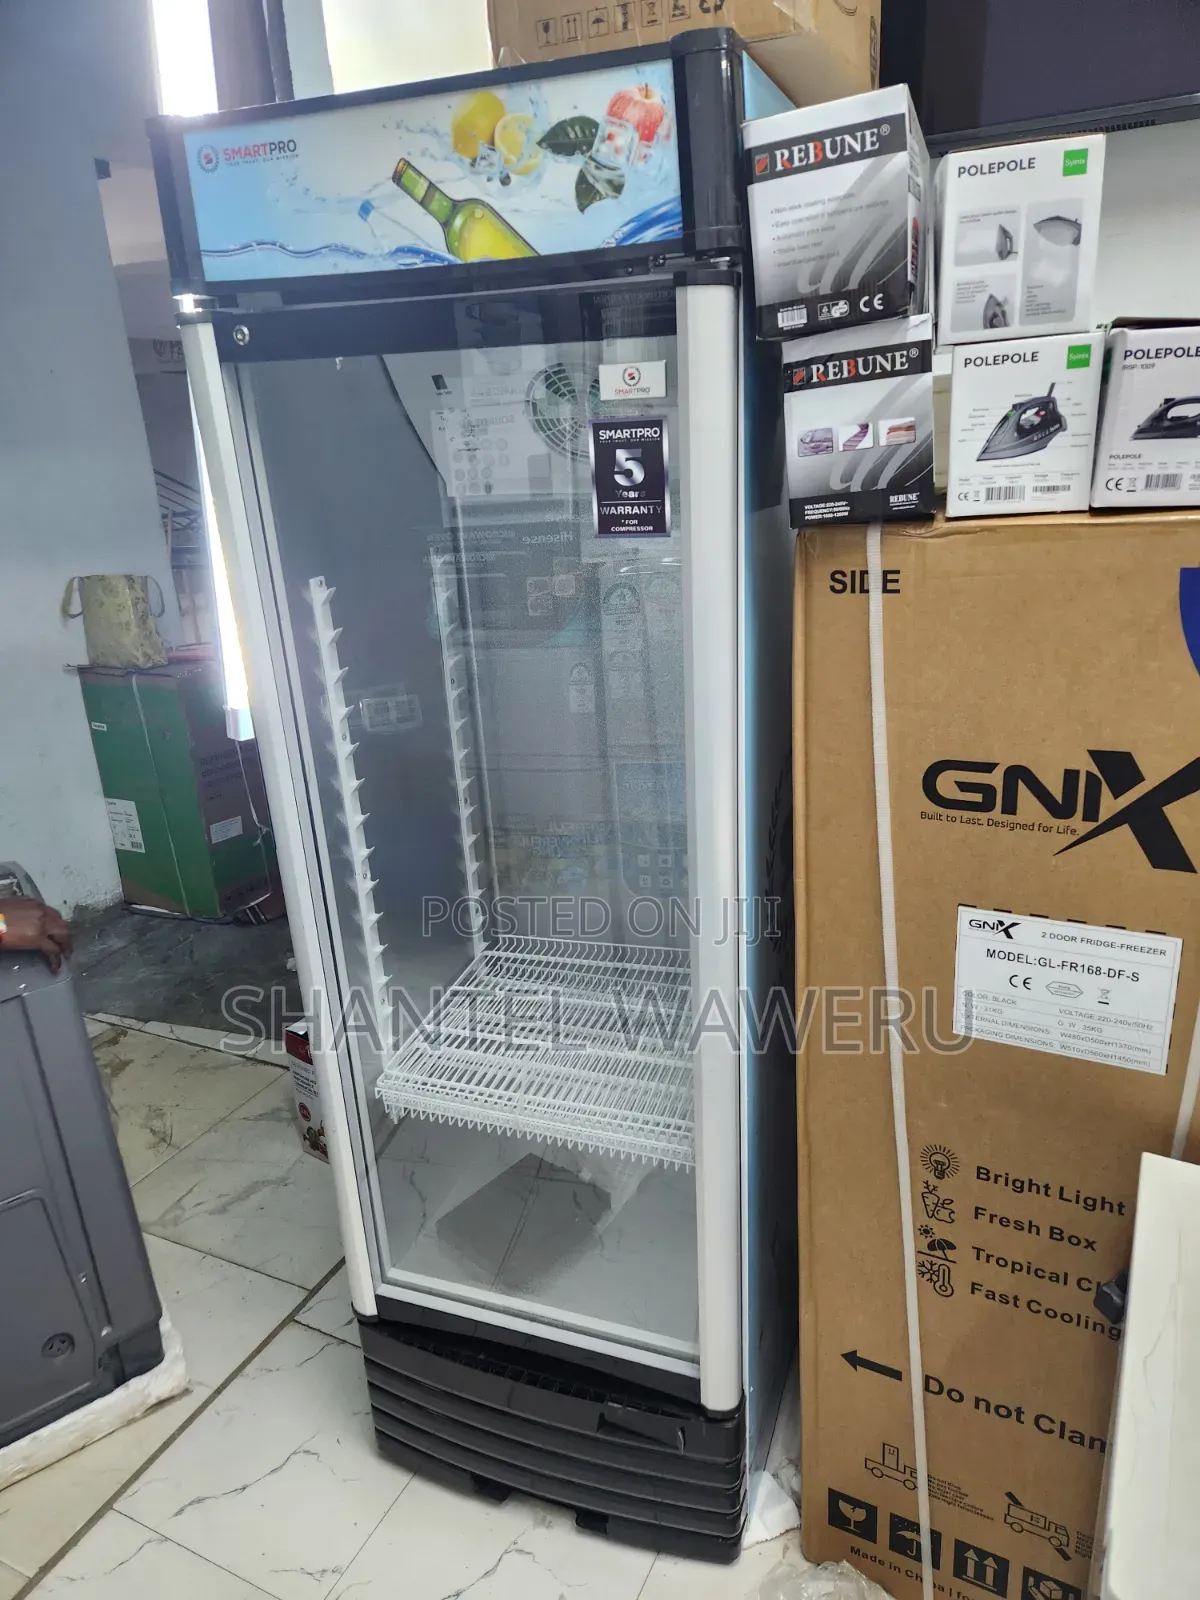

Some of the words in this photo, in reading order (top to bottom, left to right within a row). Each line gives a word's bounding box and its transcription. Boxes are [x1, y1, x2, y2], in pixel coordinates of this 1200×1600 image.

[223, 139, 297, 162] SMARTPRO
[957, 157, 1036, 178] POLEPOLE
[964, 351, 1040, 369] POLEPOLE
[1123, 346, 1200, 360] POLEPOLE
[614, 386, 650, 396] SMARTPRO
[598, 427, 660, 440] SMARTPRO
[613, 448, 646, 486] 5
[616, 490, 646, 498] Years
[889, 492, 919, 503] REBUNE
[600, 504, 662, 515] WARRANTY
[920, 811, 943, 820] Built
[946, 814, 957, 822] to
[960, 816, 984, 826] Last.
[987, 818, 1034, 832] Designed
[1038, 823, 1052, 833] for
[1056, 826, 1080, 836] Life.
[968, 920, 1022, 940] GNIX
[1050, 933, 1078, 944] DOOR
[1080, 938, 1166, 956] FRIDGE-FREEZER
[986, 948, 1140, 982] MODEL:GL-FR168-DF-S
[984, 1006, 1003, 1014] 31KG
[992, 996, 1018, 1006] BLACK
[962, 1013, 1000, 1026] EXTERNAL
[1082, 1024, 1104, 1034] 35KG
[960, 1024, 1004, 1038] PACKAGING
[976, 1166, 1051, 1198] Bright
[1058, 1186, 1126, 1217] Light
[974, 1206, 1041, 1236] Fresh
[1049, 1226, 1098, 1252] Box
[971, 1246, 1068, 1288] Tropical
[1076, 1276, 1102, 1294] Cl
[970, 1282, 1020, 1309] Fast
[1026, 1300, 1122, 1342] Cooling
[924, 1374, 965, 1404] Do
[974, 1396, 1026, 1425] not
[850, 1546, 885, 1566] Made
[889, 1562, 902, 1573] in
[905, 1569, 944, 1592] Cha
